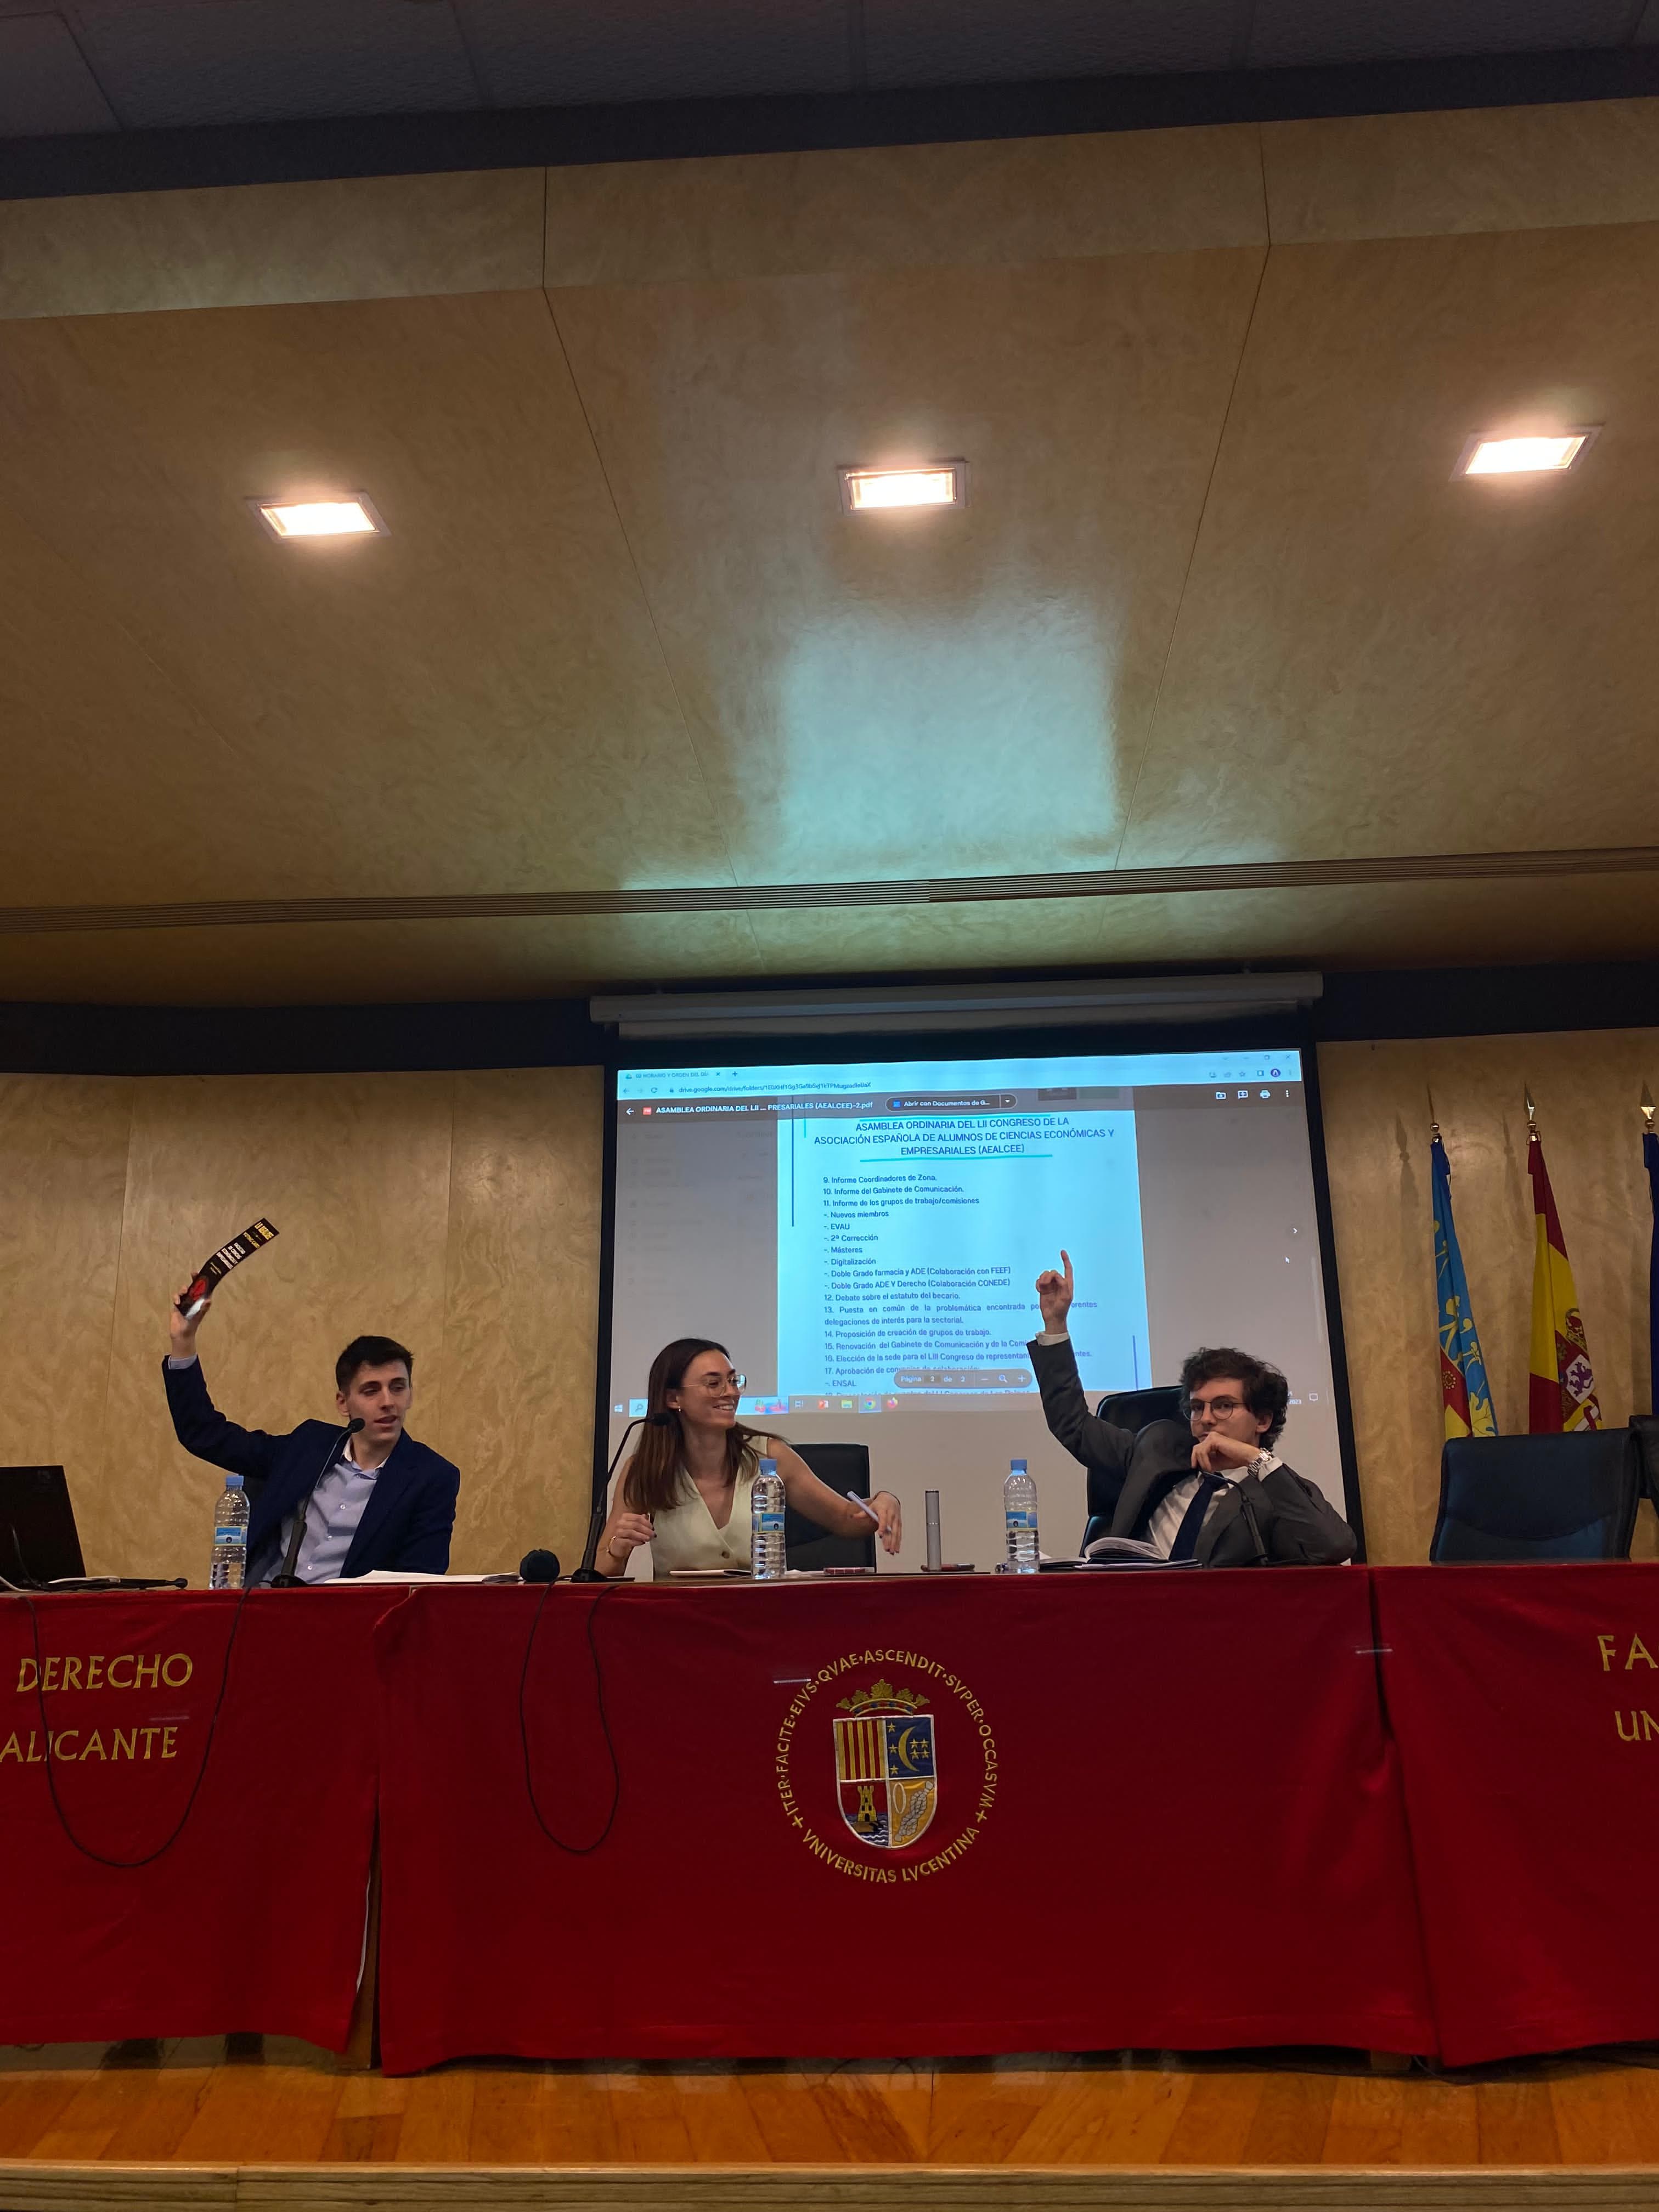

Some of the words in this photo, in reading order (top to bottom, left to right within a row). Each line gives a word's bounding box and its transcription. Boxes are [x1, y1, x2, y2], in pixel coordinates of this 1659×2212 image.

[815, 1101, 873, 1110] (AEALCEE)-2.pdf
[856, 1122, 904, 1131] ASAMBLEA
[906, 1120, 956, 1129] ORDINARIA
[958, 1120, 975, 1128] DEL
[978, 1120, 987, 1128] LII
[990, 1118, 1041, 1127] CONGRESO
[814, 1134, 871, 1144] ASOCIACIÓN
[873, 1133, 921, 1143] ESPAÑOLA
[938, 1133, 983, 1142] ALUMNOS
[985, 1132, 997, 1141] DE
[1000, 1131, 1042, 1140] CIENCIAS
[1044, 1128, 1105, 1139] ECONÓMICAS
[901, 1146, 976, 1155] EMPRESARIALES
[979, 1144, 1024, 1154] (AEALCEE)
[915, 1197, 979, 1206] trabajo/comisiones
[831, 1258, 876, 1266] Digitalización
[927, 1267, 975, 1276] (Colaboración
[928, 1279, 977, 1288] (Colaboración
[936, 1304, 981, 1312] problemática
[825, 1318, 870, 1326] delegaciones
[836, 1330, 876, 1339] Proposición
[934, 1340, 984, 1348] Comunicación
[940, 1352, 974, 1361] Congreso
[986, 1352, 1029, 1361] representan
[836, 1367, 874, 1375] Aprobación
[818, 1654, 859, 1681] QVAE
[865, 1650, 945, 1677] ASCENDIT
[16, 1653, 193, 1692] DERECHO
[790, 1682, 817, 1716] EIVS
[945, 1675, 984, 1723] SVPER
[0, 1726, 178, 1763] ALICANTE
[776, 1718, 796, 1773] FACITE
[979, 1725, 998, 1808] OCCASVM
[777, 1779, 799, 1817] ITER
[803, 1829, 896, 1883] VNIVERSITAS
[902, 1827, 980, 1882] LVCENTINA
